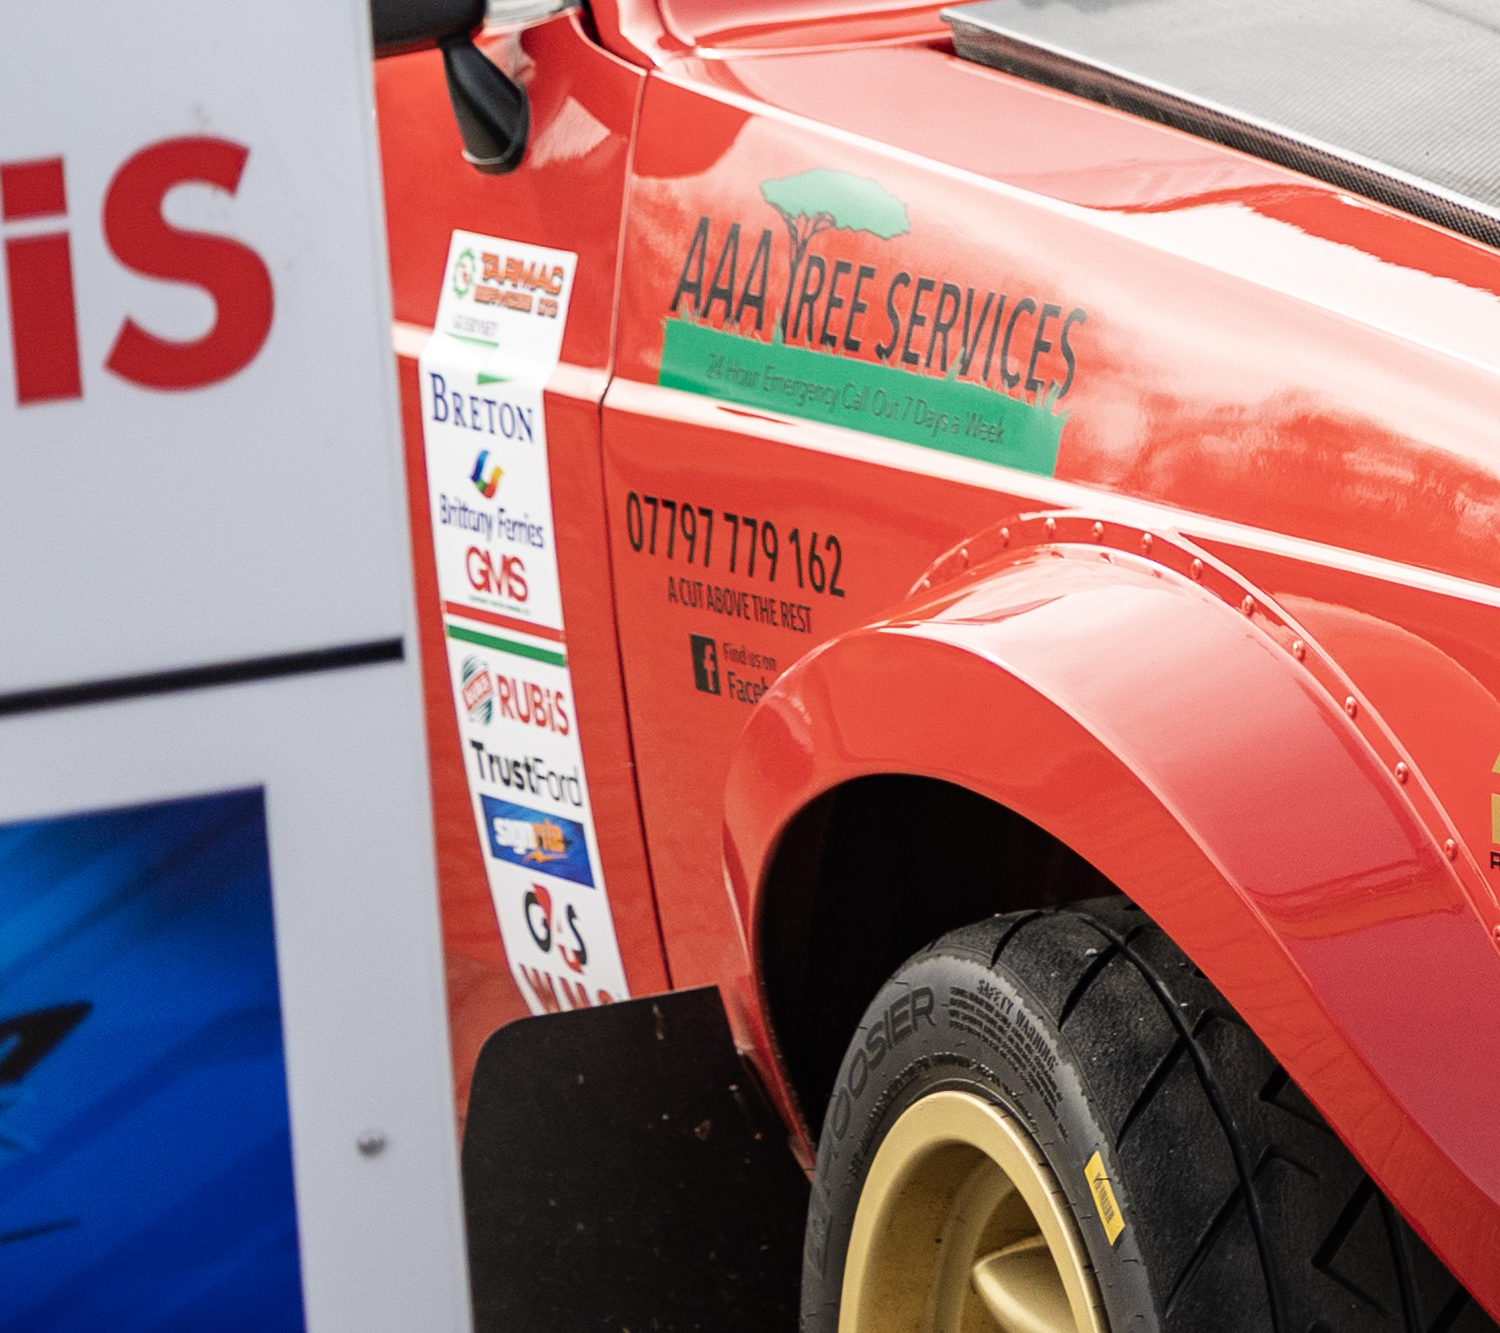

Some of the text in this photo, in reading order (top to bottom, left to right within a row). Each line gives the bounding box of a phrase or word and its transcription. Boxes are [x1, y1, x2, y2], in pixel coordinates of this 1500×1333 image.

[669, 216, 773, 331] AAA
[875, 271, 1088, 399] SERVICES
[429, 371, 534, 443] BRETON
[440, 493, 545, 549] Brittany Ferries
[627, 491, 845, 598] 07797 779 162
[466, 546, 529, 603] GMS
[668, 575, 812, 633] A CUT ABOVE THE REST
[469, 738, 583, 808] TrustFord
